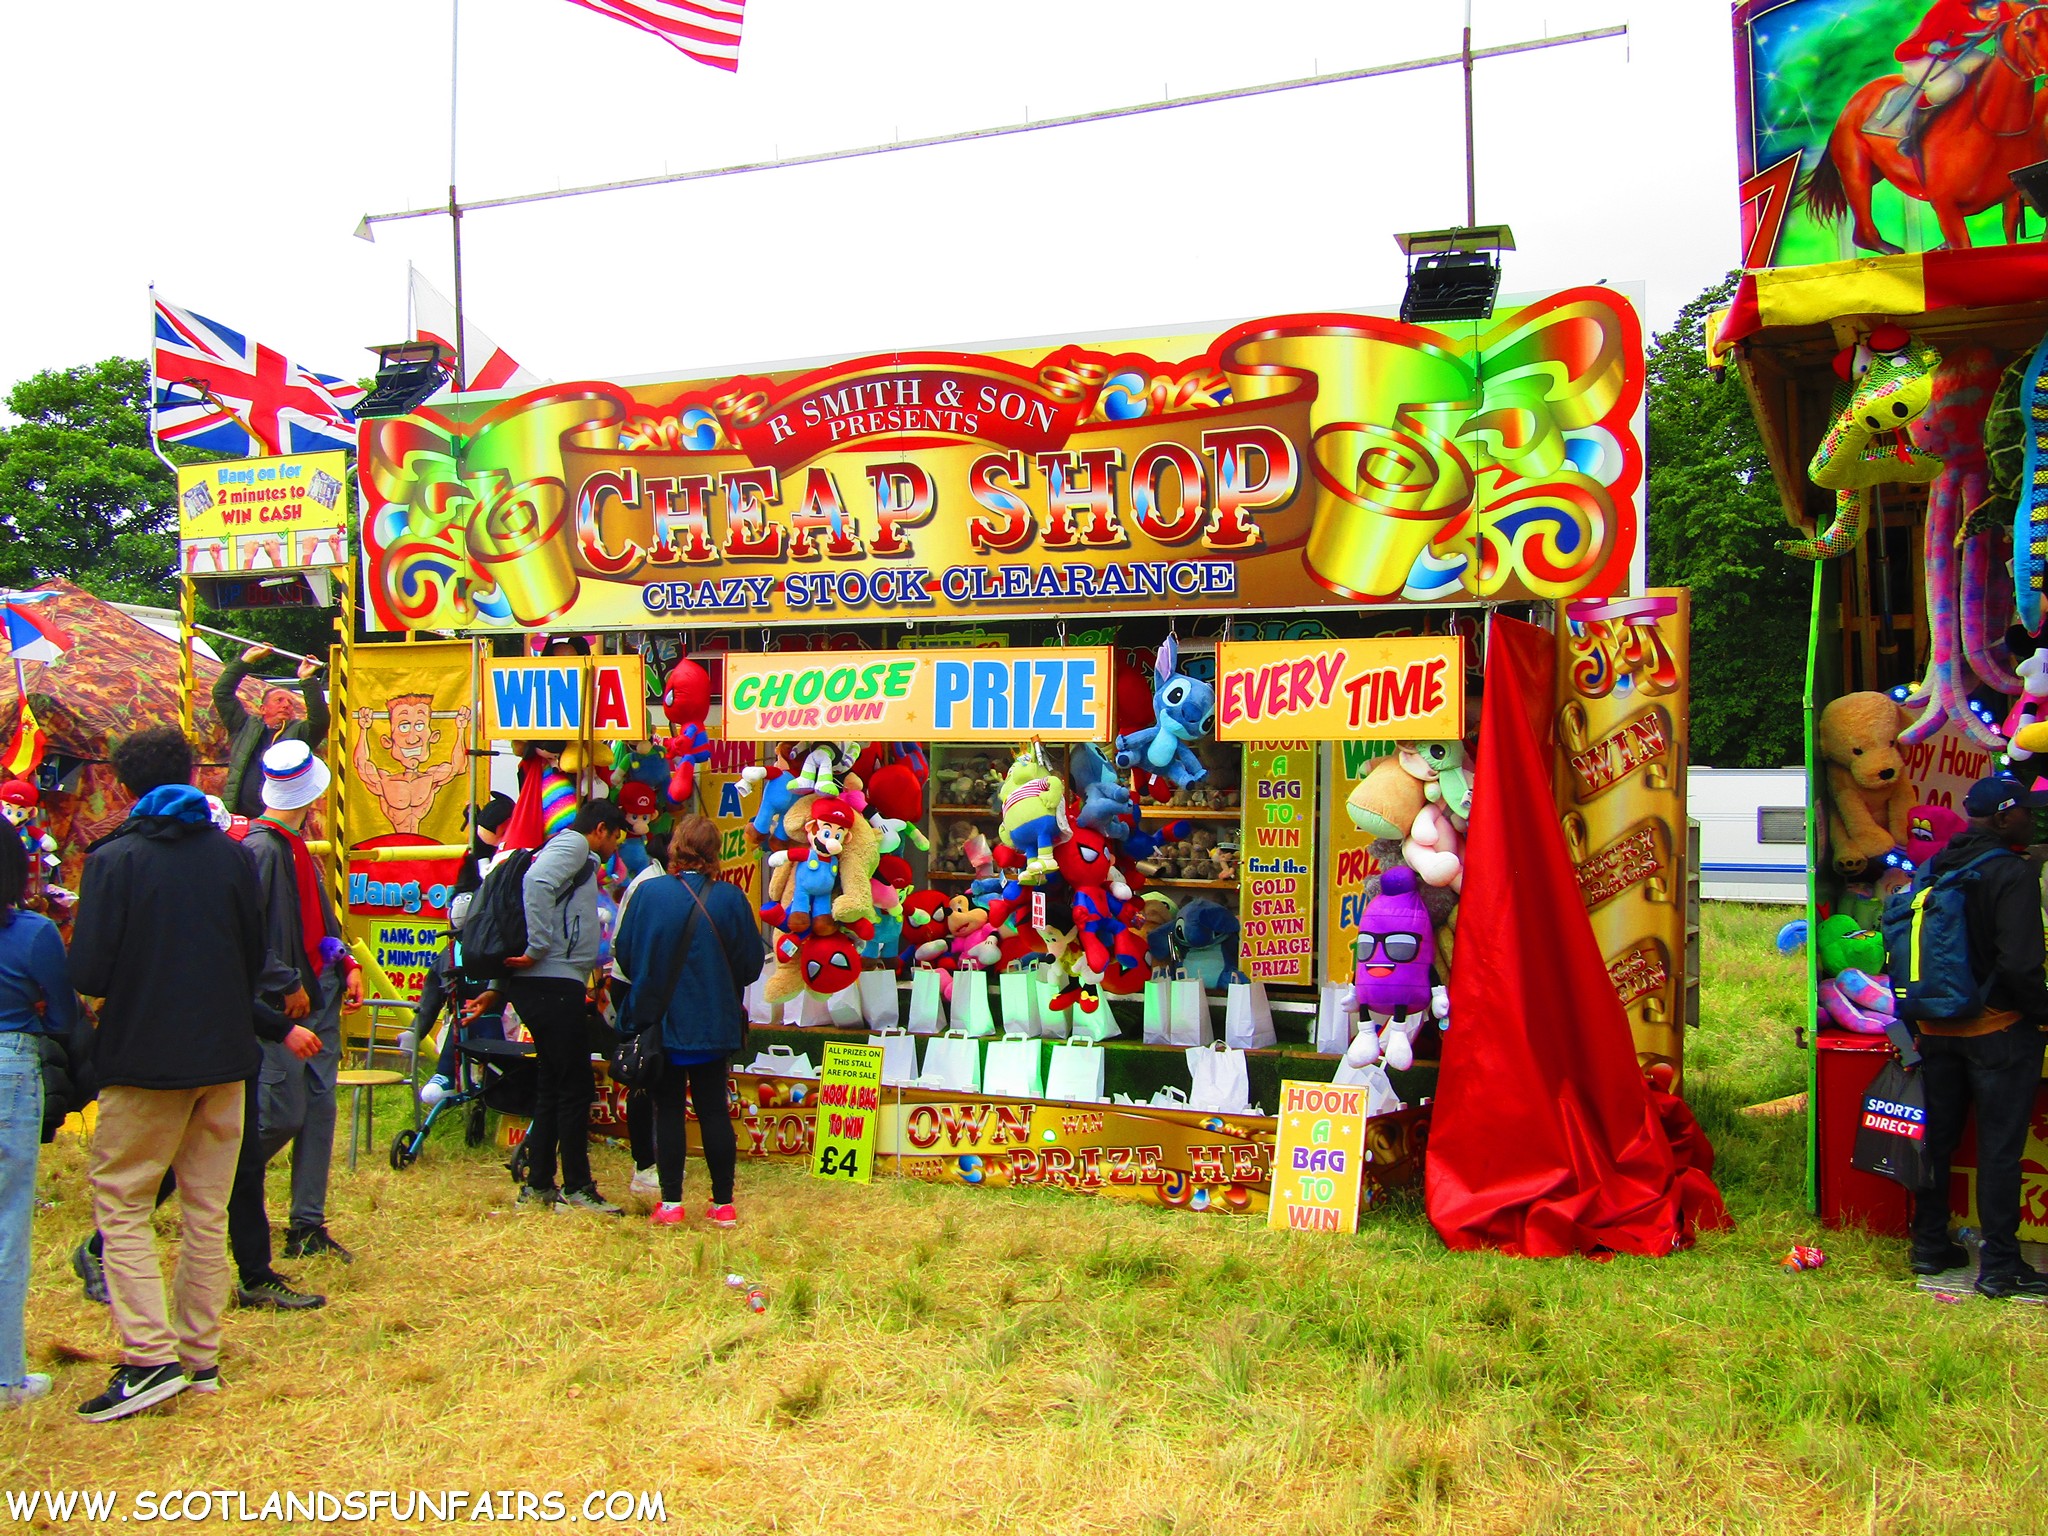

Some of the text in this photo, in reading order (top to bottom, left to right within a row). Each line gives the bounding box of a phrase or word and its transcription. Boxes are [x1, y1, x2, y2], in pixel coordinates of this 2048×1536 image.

[767, 379, 1058, 445] R SMITH & SON
[827, 409, 978, 442] PRESENTS
[218, 464, 302, 485] Hang on for
[218, 485, 305, 505] 2 minutes to
[576, 425, 1298, 575] CHEAP SHOP
[221, 504, 302, 525] WIN CASH
[642, 561, 1235, 611] CRAZY STOCK CLEARANCE
[492, 667, 582, 729] WIN
[594, 668, 631, 729] A
[733, 660, 918, 710] CHOOSE
[934, 660, 1095, 730] PRIZE
[1221, 651, 1346, 725] EVERY
[1344, 658, 1447, 728] TIME
[759, 702, 884, 731] YOUR OWN
[710, 740, 756, 773] WIN
[1571, 712, 1664, 789] WIN
[1938, 735, 1988, 780] Hour
[1272, 756, 1287, 777] A
[718, 782, 743, 817] A
[1258, 780, 1301, 801] BAG
[1264, 804, 1293, 823] TO
[1256, 827, 1300, 848] WIN
[1249, 858, 1307, 874] find the
[1575, 827, 1655, 885] LUCKY
[1252, 878, 1296, 896] GOLD
[1588, 851, 1658, 904] BAGS
[1252, 899, 1296, 917] STAR
[380, 927, 437, 946] HANG ON
[1245, 918, 1305, 937] TO WIN
[377, 948, 384, 966] 2
[1240, 938, 1311, 957] A LARGE
[409, 971, 427, 990] £2
[1252, 959, 1299, 977] PRIZE
[828, 1047, 880, 1058] ALL PRIZES ON
[834, 1058, 873, 1068] THIS STALL
[827, 1069, 877, 1079] ARE FOR SALE
[821, 1084, 877, 1111] HOOK A BAG
[1288, 1089, 1360, 1116] HOOK
[1867, 1098, 1924, 1121] SPORTS
[829, 1113, 864, 1140] TO WIN
[907, 1104, 1103, 1149] OWN WIN
[1313, 1119, 1331, 1143] A
[1865, 1114, 1919, 1136] DIRECT
[820, 1146, 858, 1178] £4
[909, 1157, 943, 1178] WIN
[1008, 1144, 1164, 1189] PRIZE
[1293, 1147, 1345, 1173] BAG
[1300, 1176, 1334, 1202] TO
[1288, 1205, 1340, 1231] WIN
